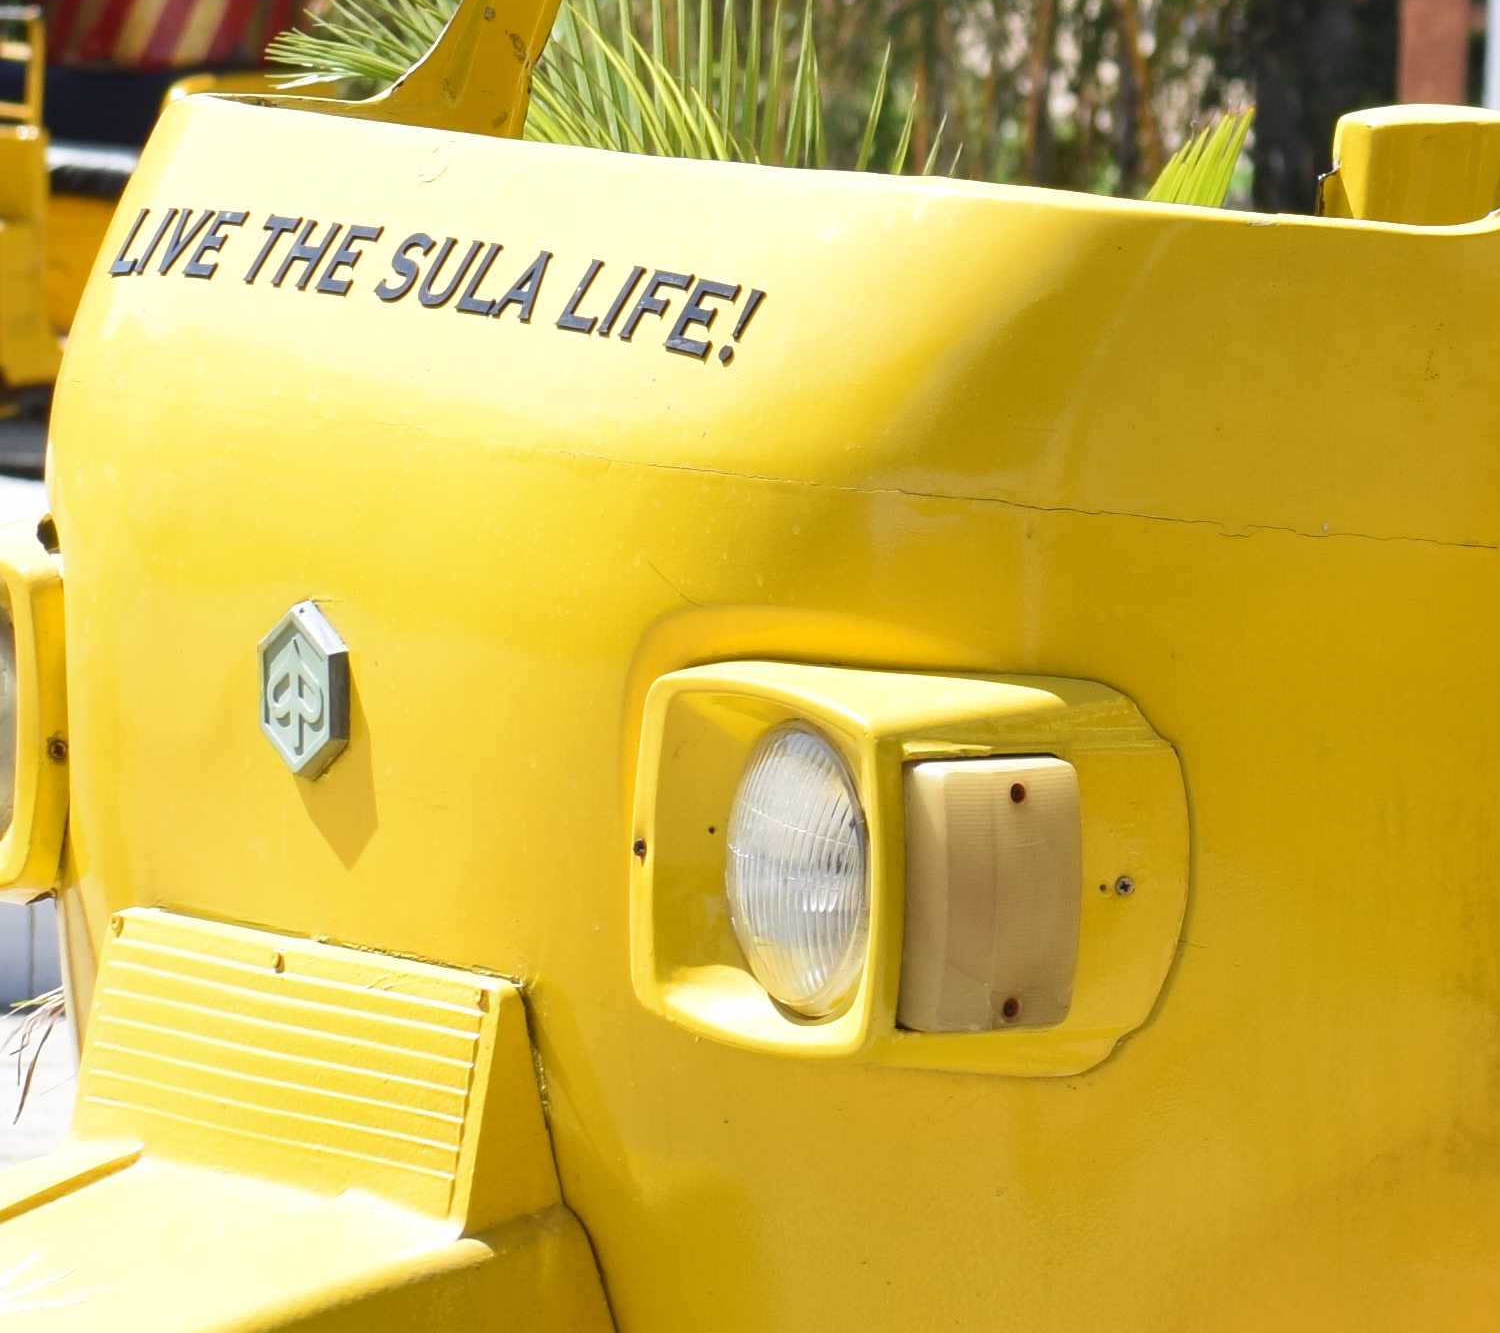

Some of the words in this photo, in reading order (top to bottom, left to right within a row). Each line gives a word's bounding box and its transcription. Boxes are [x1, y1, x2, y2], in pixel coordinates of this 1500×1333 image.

[108, 208, 250, 280] LIVE
[243, 213, 386, 297] THE
[374, 232, 553, 325] SULA
[555, 258, 767, 367] LIFE!
